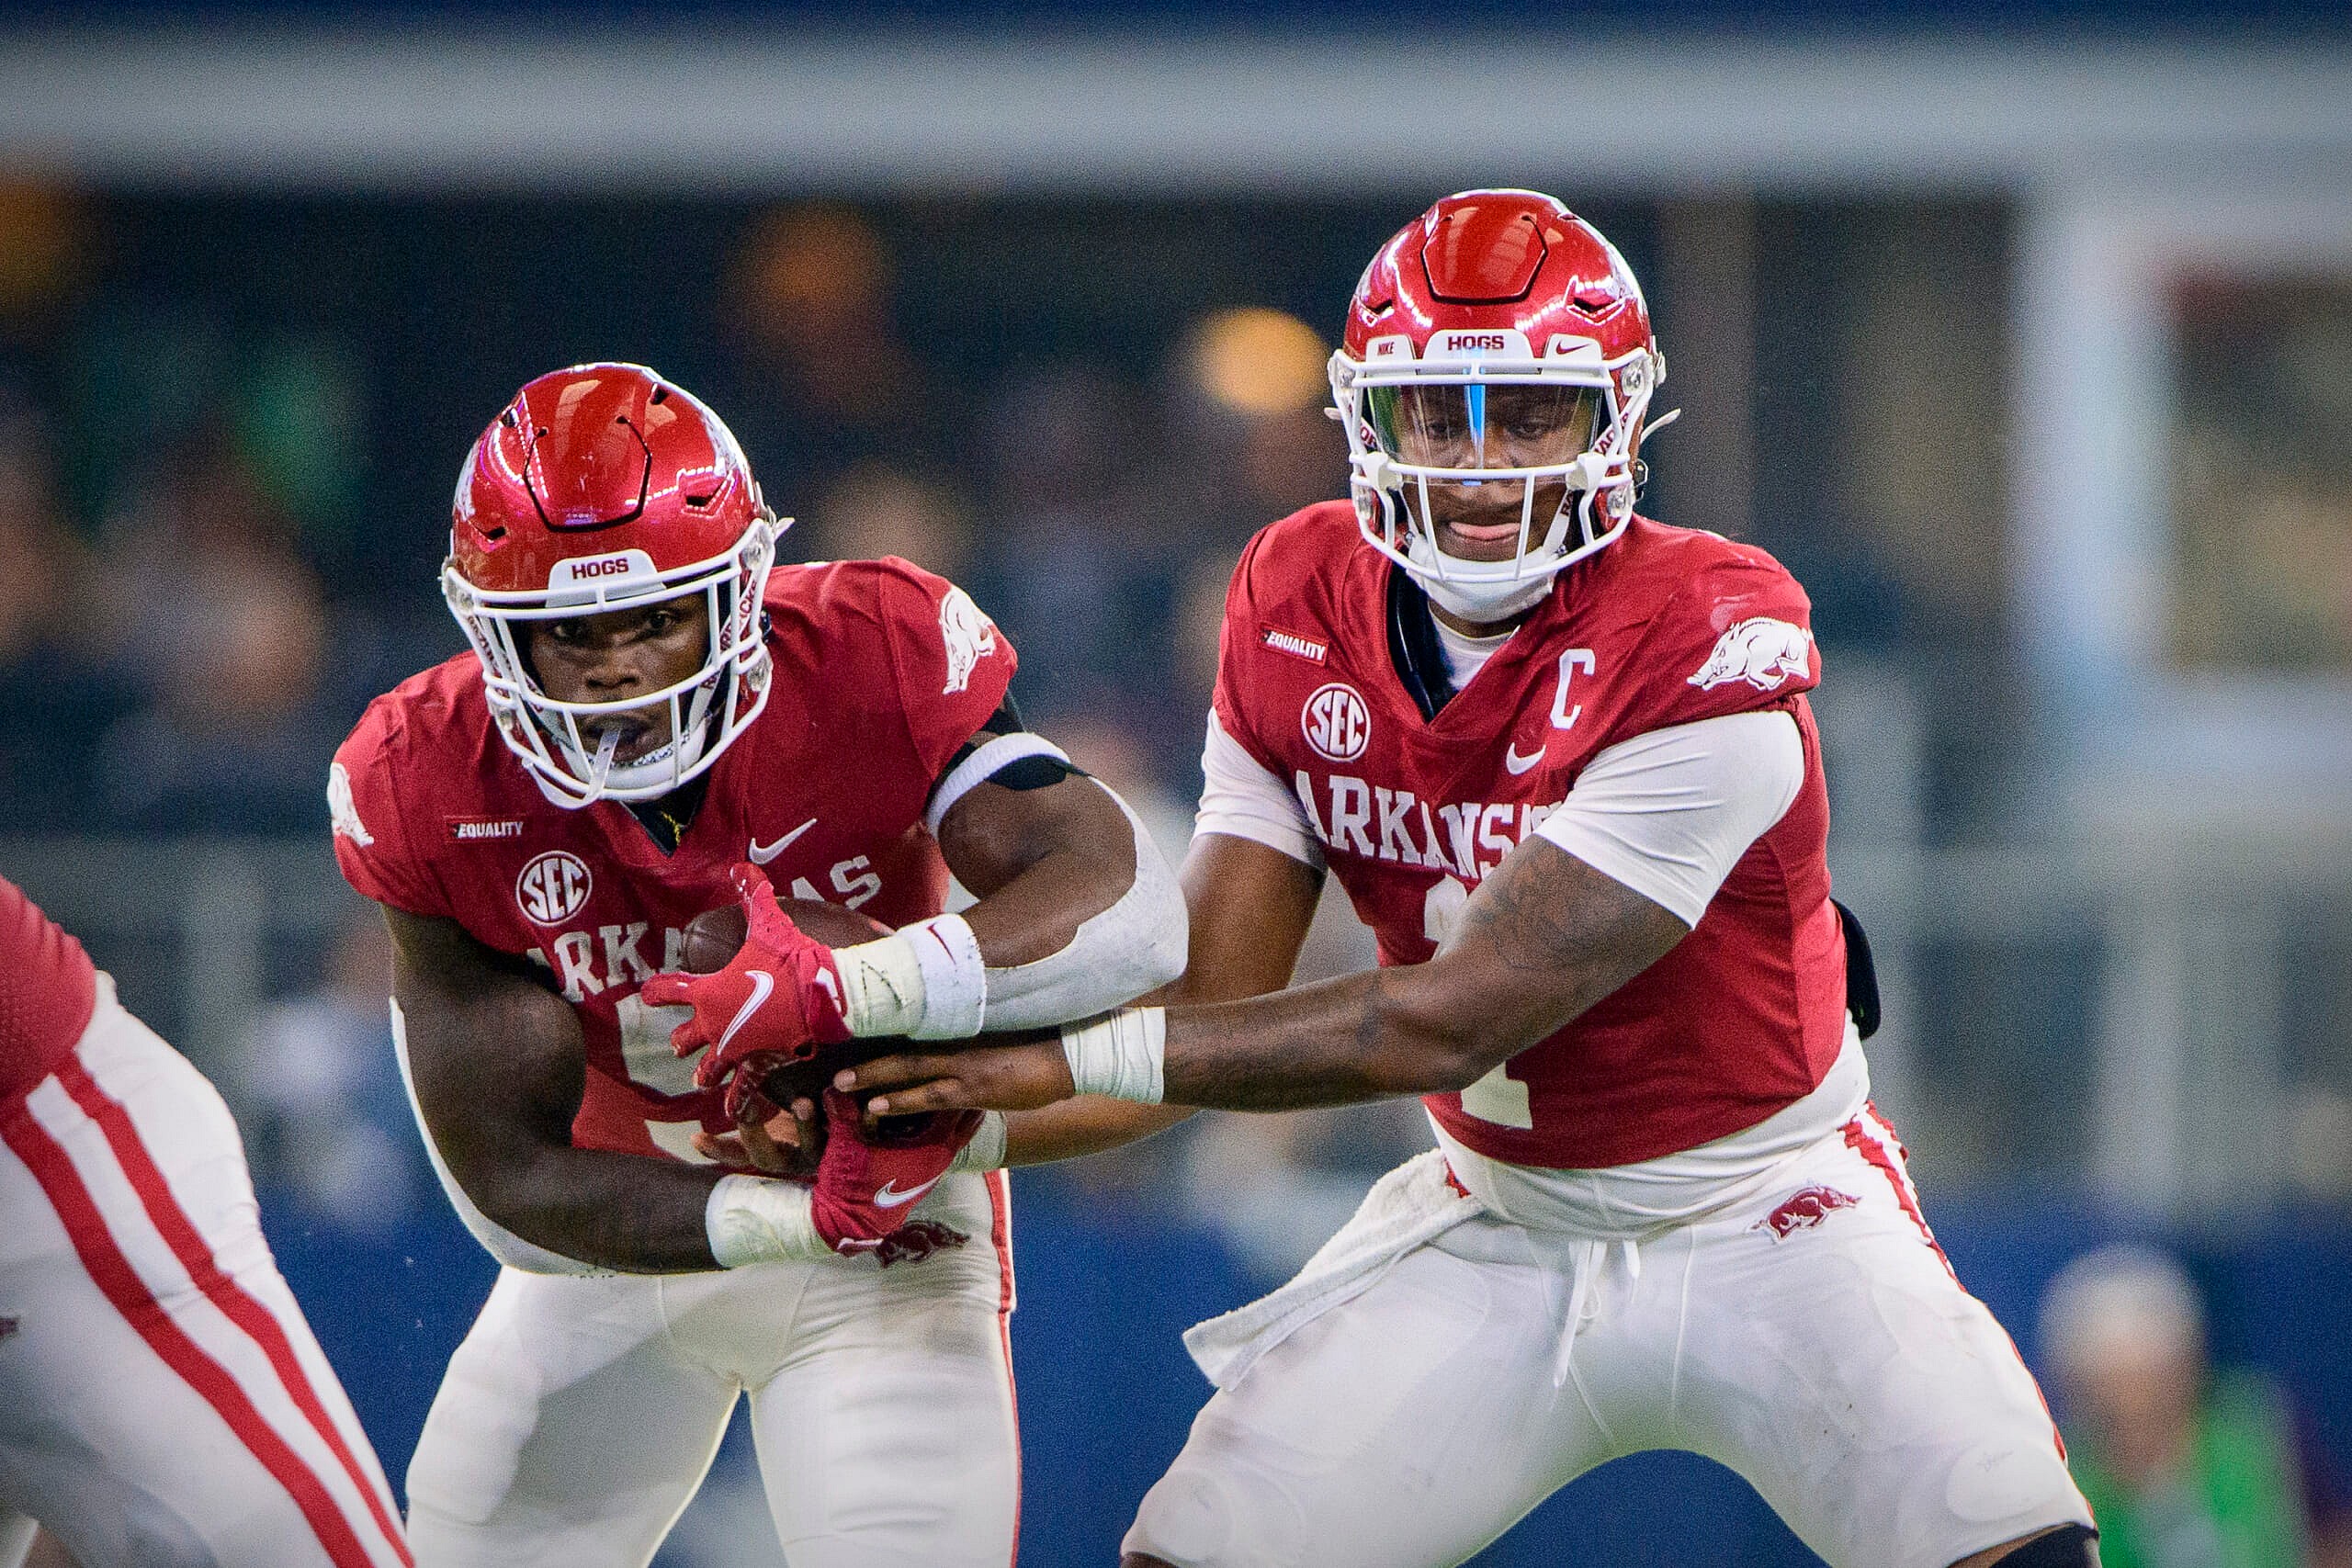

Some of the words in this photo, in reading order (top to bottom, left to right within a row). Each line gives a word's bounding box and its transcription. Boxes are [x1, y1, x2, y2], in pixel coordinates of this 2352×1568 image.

[1377, 341, 1395, 355] NIKE
[1448, 335, 1504, 350] HOGS
[572, 557, 629, 580] HOGS
[1266, 630, 1327, 661] EQUALITY
[1549, 648, 1597, 730] C
[1310, 690, 1364, 758] SEC
[457, 821, 524, 839] EQUALITY
[522, 857, 584, 919] SEC
